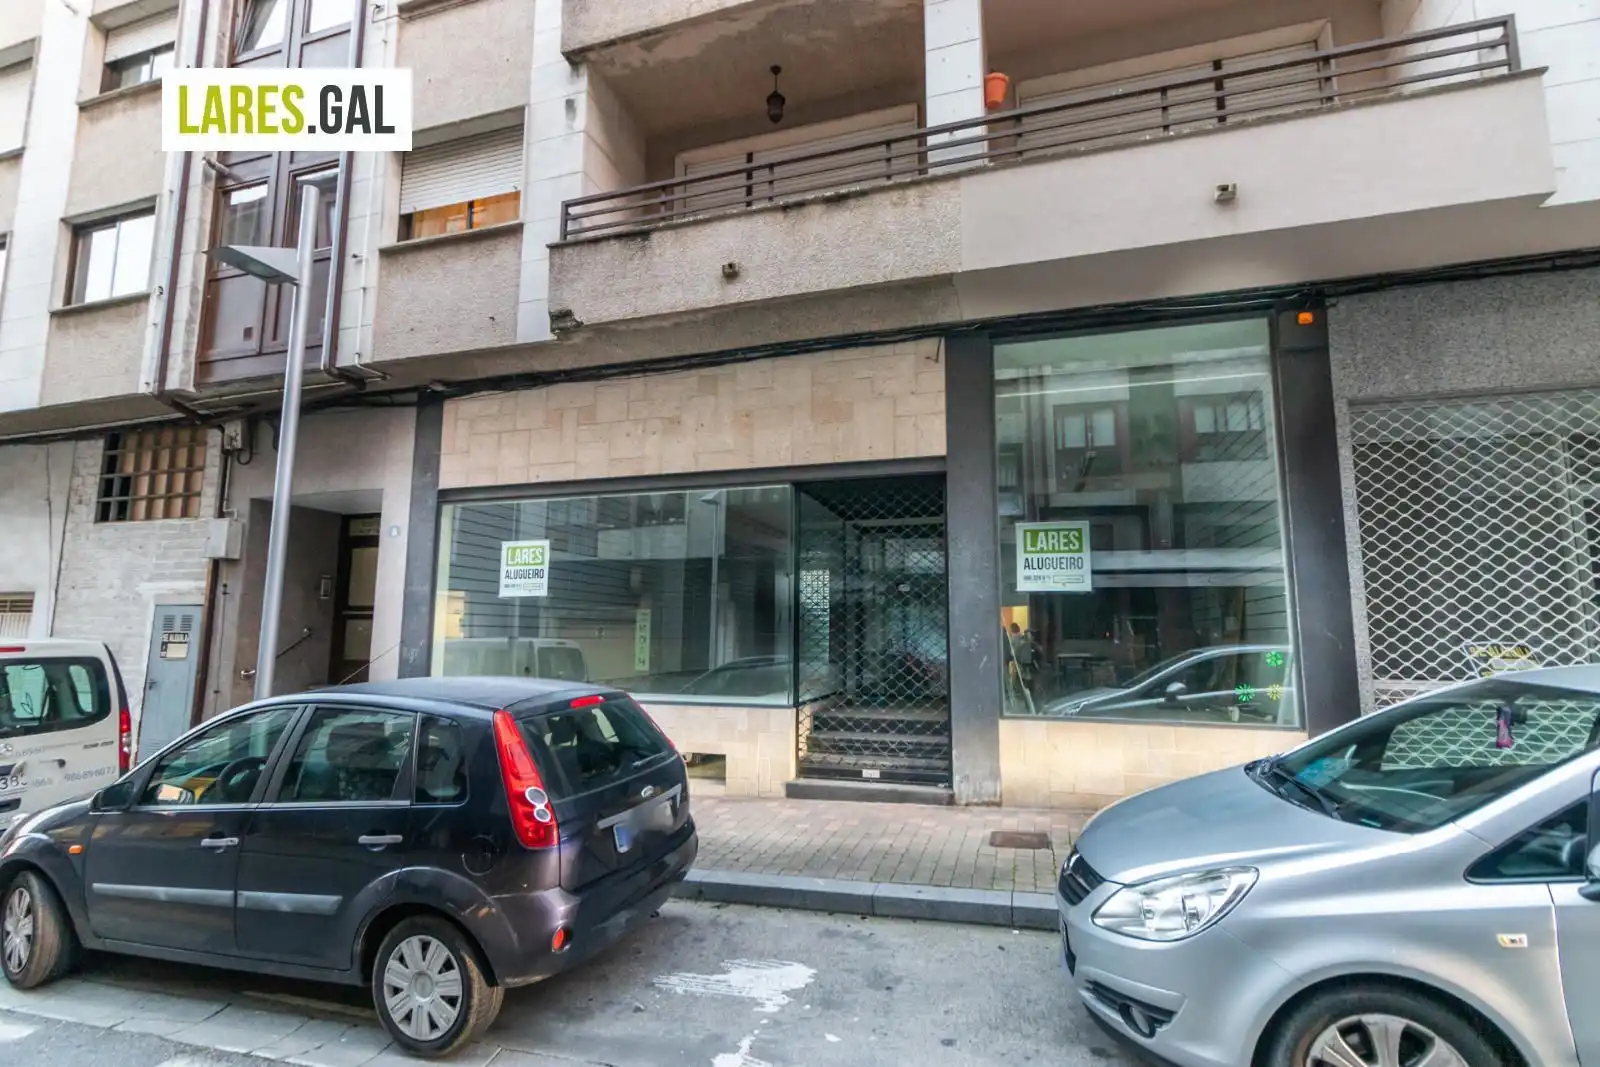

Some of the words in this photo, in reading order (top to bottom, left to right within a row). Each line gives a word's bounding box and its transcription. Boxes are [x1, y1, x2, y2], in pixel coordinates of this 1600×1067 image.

[1025, 530, 1080, 551] LARES
[507, 547, 544, 565] LARES
[1023, 556, 1084, 570] ALUGUEIRO
[504, 568, 545, 580] ALUGUEIRO
